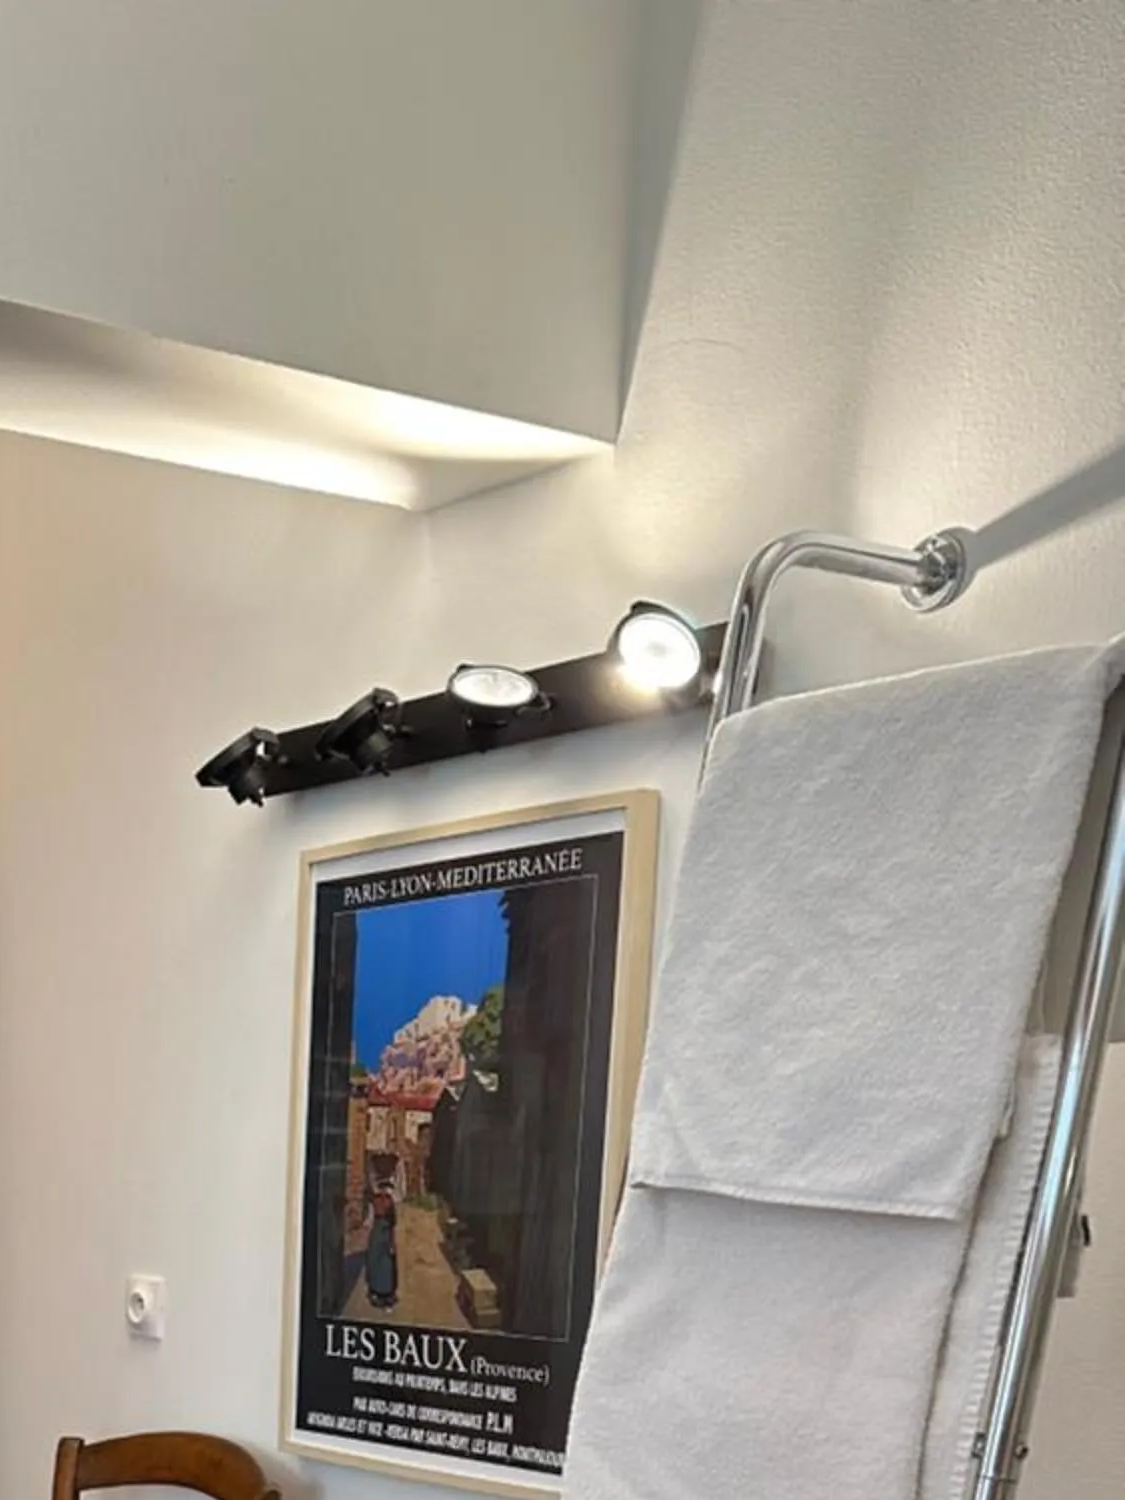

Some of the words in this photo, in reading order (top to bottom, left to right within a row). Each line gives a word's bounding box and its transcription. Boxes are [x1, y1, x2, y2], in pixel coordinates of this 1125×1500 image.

[325, 1324, 376, 1362] LES
[383, 1330, 468, 1374] BAUX
[470, 1357, 551, 1387] (Provence)
[448, 1378, 469, 1396] DANS
[469, 1381, 484, 1398] LES
[406, 1403, 417, 1420] DE
[470, 1437, 486, 1455] LES
